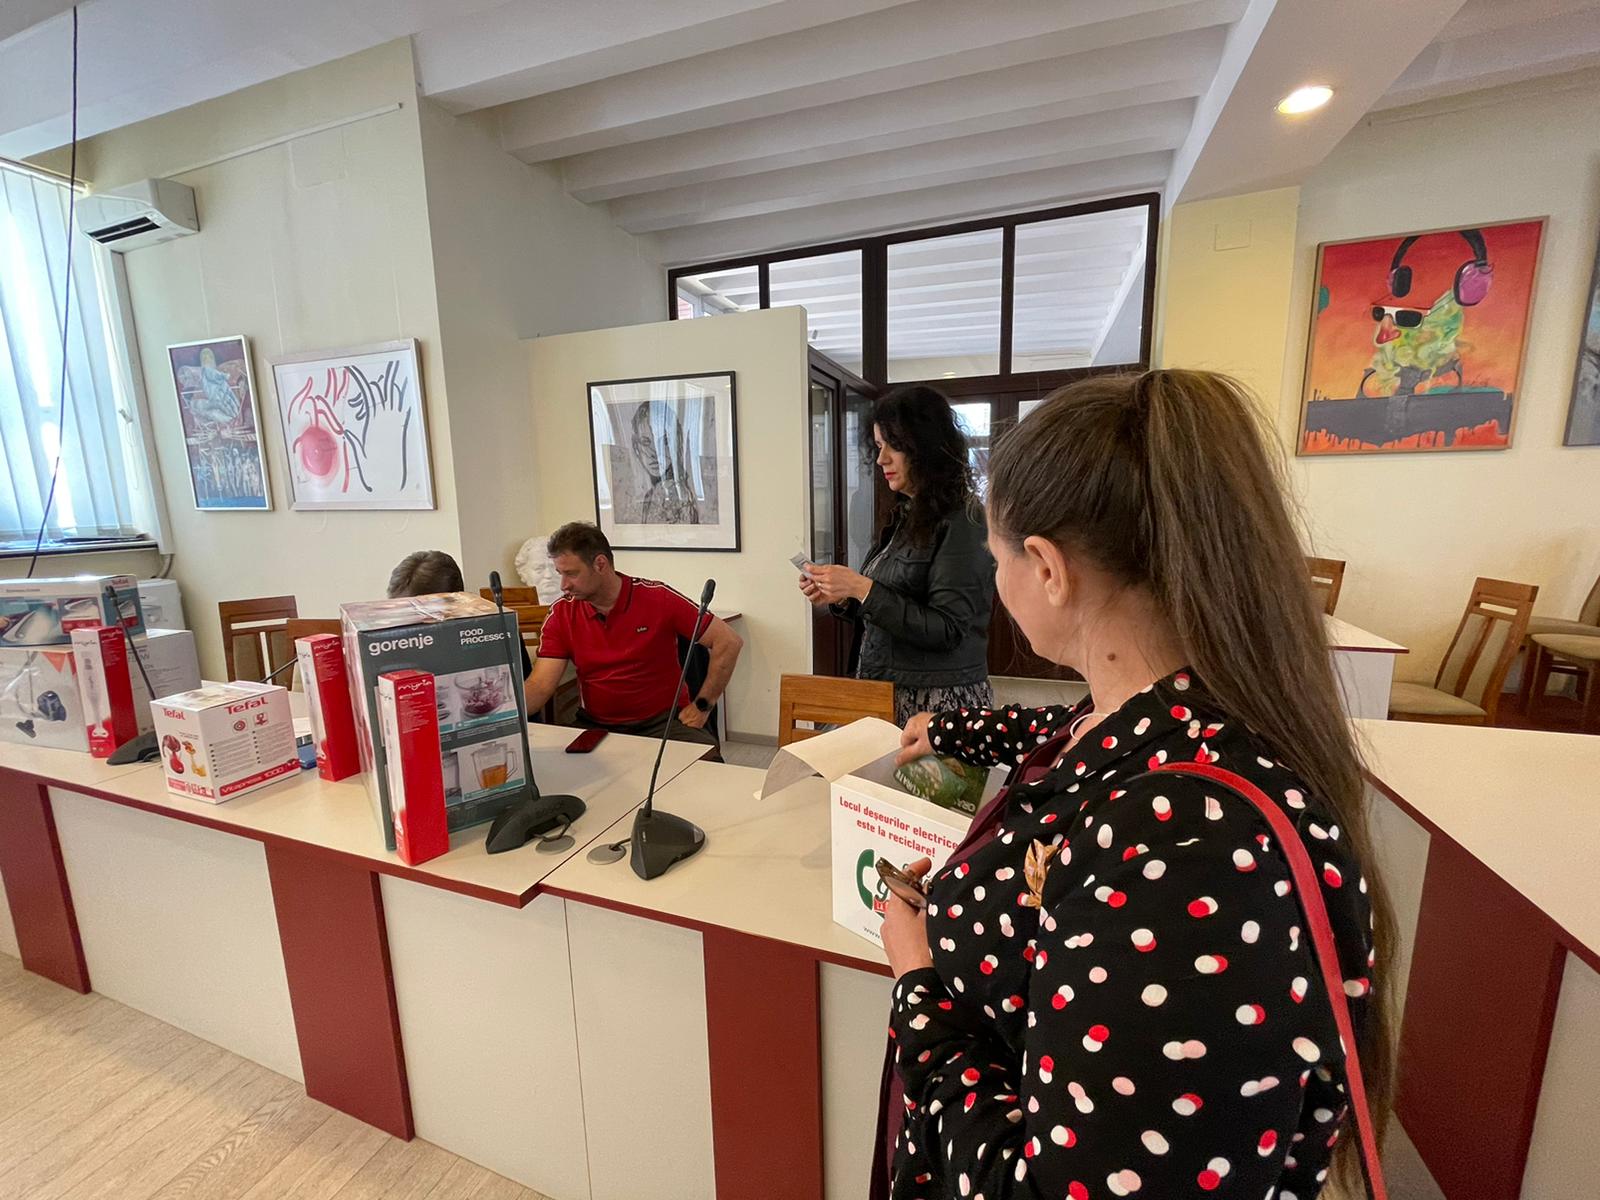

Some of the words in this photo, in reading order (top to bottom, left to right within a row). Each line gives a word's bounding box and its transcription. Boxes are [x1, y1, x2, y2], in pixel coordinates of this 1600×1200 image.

[460, 628, 484, 637] FOOD
[368, 633, 434, 656] gorenje
[163, 707, 186, 720] Tefal
[224, 696, 269, 716] Tefal
[839, 795, 861, 813] Locul
[863, 806, 911, 832] deșeurilor
[912, 826, 961, 850] electrice
[856, 819, 876, 833] este
[878, 825, 887, 838] la
[888, 831, 936, 858] reciclare!
